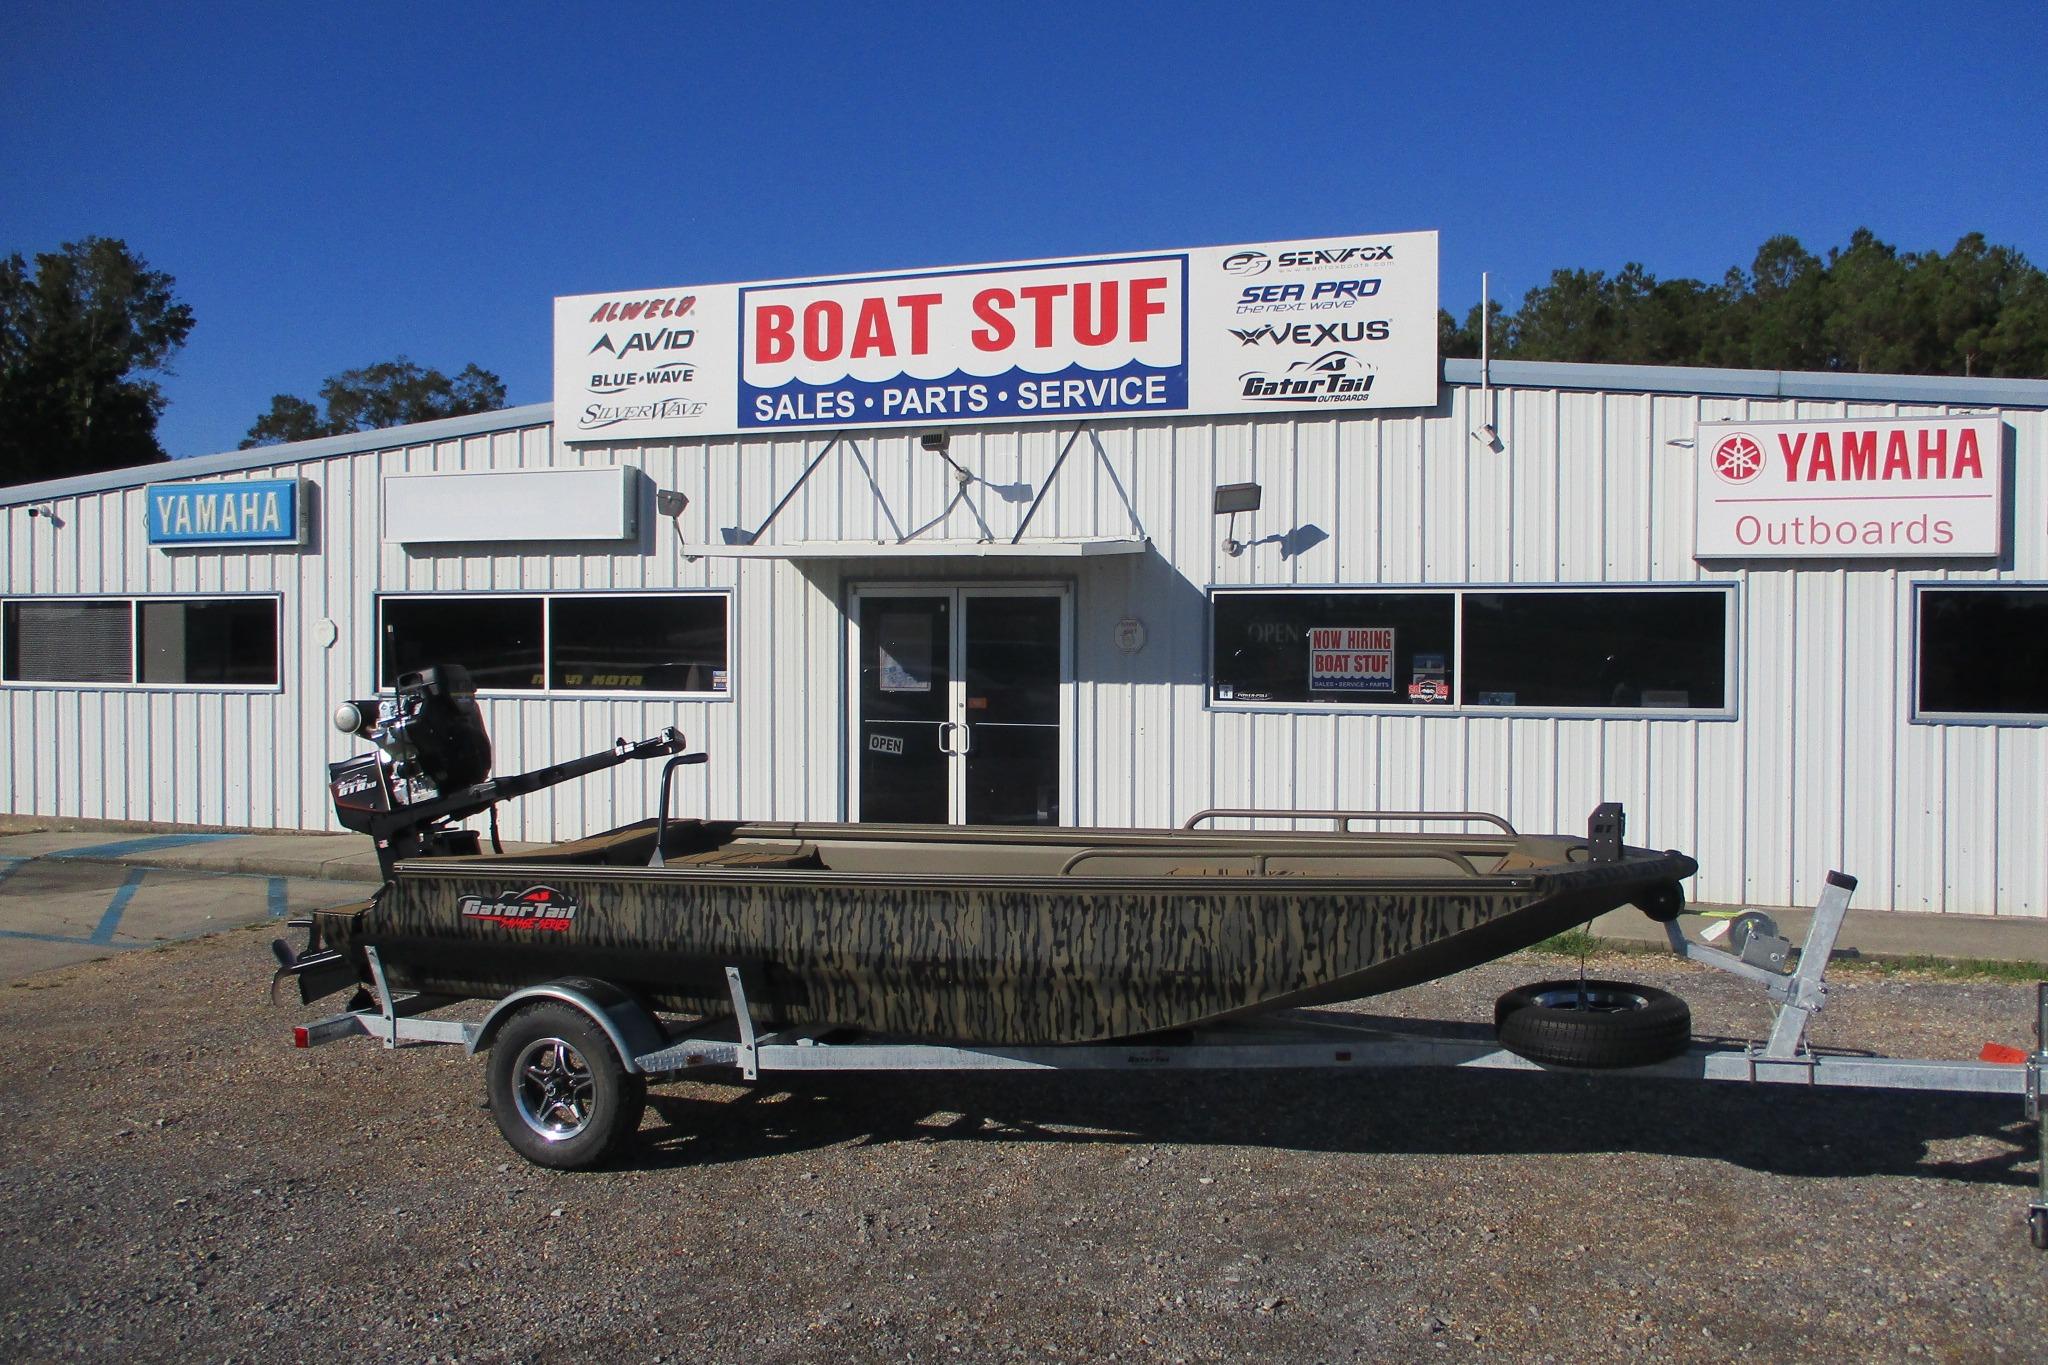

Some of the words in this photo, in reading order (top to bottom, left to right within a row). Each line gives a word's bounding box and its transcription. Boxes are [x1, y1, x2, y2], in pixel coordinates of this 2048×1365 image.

[1237, 284, 1304, 304] SEA
[1312, 278, 1381, 301] PRO
[589, 296, 696, 323] ALWELD
[1236, 305, 1264, 314] the
[1266, 302, 1306, 312] next
[1310, 300, 1355, 310] wave
[756, 293, 942, 364] BOAT
[971, 277, 1167, 352] STUF
[617, 328, 694, 359] AVID
[1268, 320, 1390, 347] VEXUS
[591, 373, 637, 387] BLUE
[647, 370, 694, 384] WAVE
[1243, 373, 1375, 396] GatorTail
[755, 390, 855, 421] SALES
[883, 385, 988, 416] PARTS
[1017, 375, 1167, 410] SERVICE
[1318, 394, 1369, 403] OUTBOARDS
[1777, 428, 1983, 482] YAMAHA
[157, 491, 282, 535] YAMAHA
[1735, 514, 1954, 545] Outboards
[1248, 623, 1299, 642] OPEN
[1313, 630, 1341, 649] NOW
[1347, 630, 1391, 649] HIRING
[1315, 654, 1350, 672] BOAT
[1354, 654, 1389, 672] STUF
[871, 736, 902, 752] OPEN
[462, 900, 576, 919] GatorTail
[538, 919, 570, 932] SERIES
